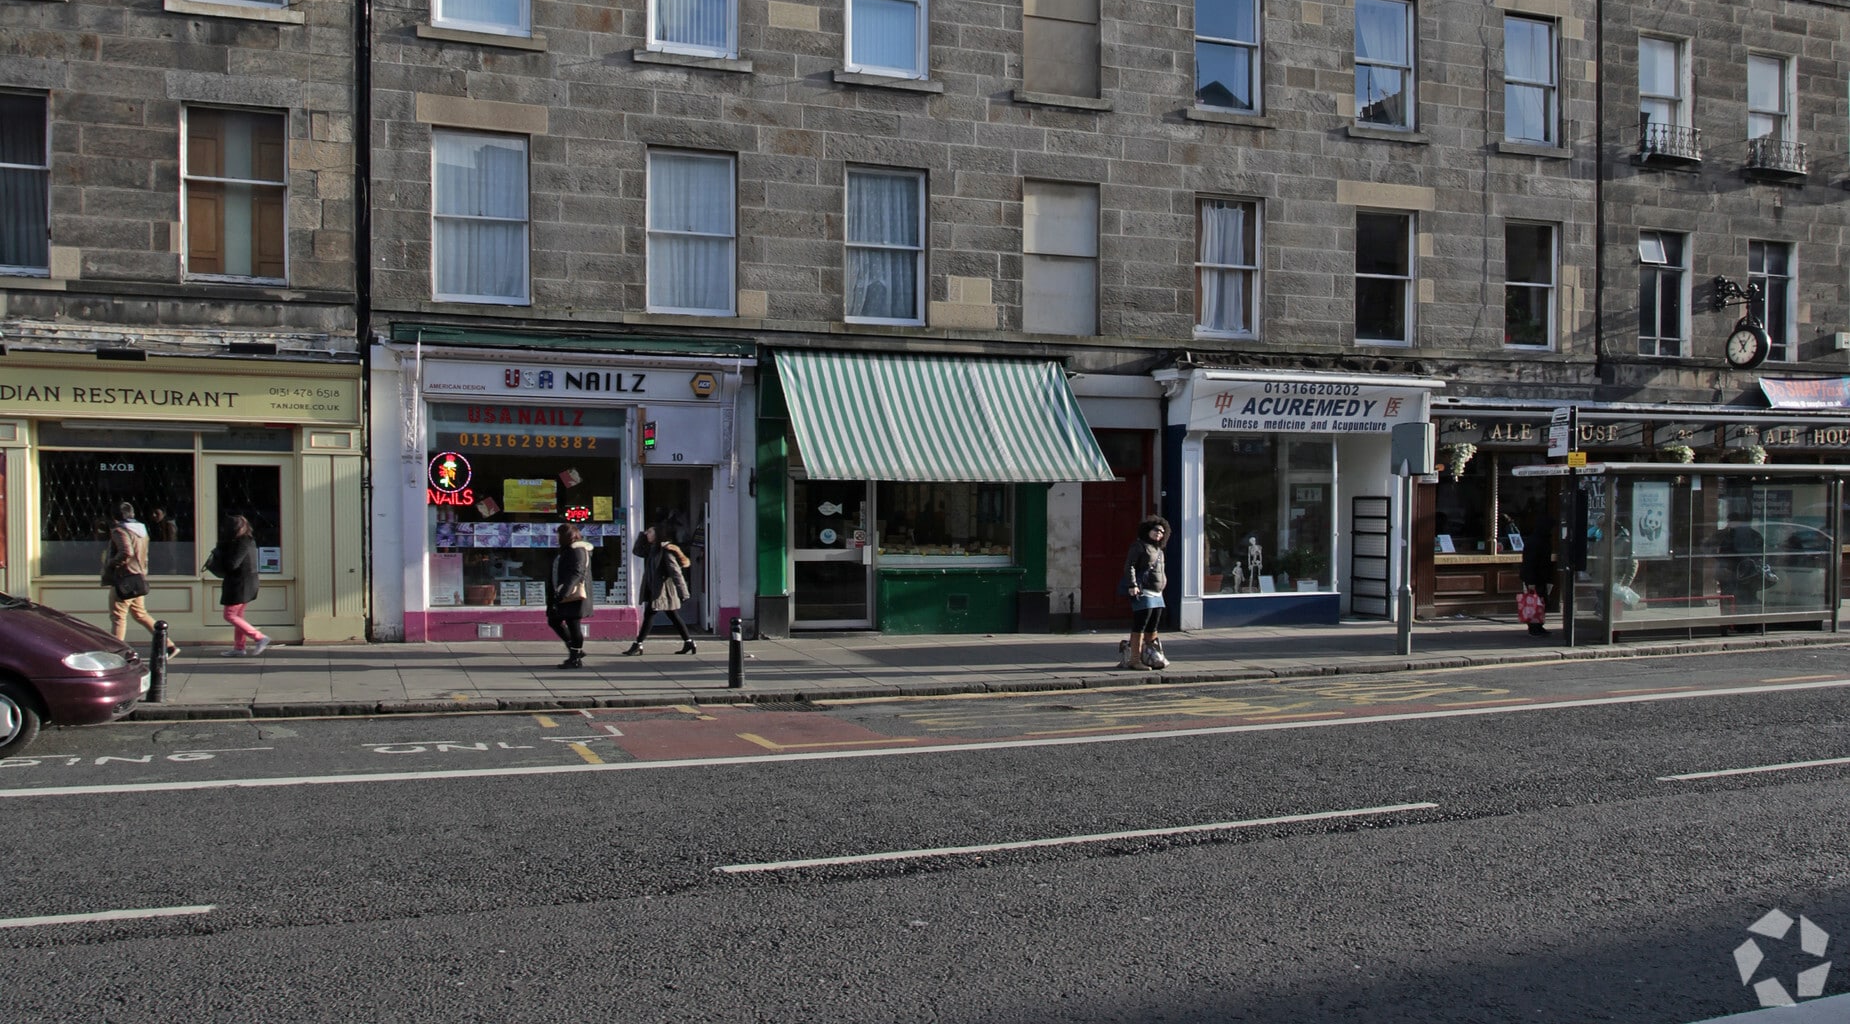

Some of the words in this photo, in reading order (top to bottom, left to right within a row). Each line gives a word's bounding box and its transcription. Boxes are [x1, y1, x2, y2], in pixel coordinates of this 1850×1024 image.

[505, 368, 554, 390] USA
[566, 372, 646, 392] NAILZ
[0, 384, 60, 402] DIAN
[72, 387, 239, 408] RESTAURANT
[269, 388, 290, 397] 0131
[293, 388, 313, 398] 478
[316, 388, 340, 398] 6518
[1264, 382, 1360, 396] 01316620202
[270, 402, 340, 411] TANJORE.CO.UK
[1214, 392, 1234, 414] 中
[1241, 398, 1377, 417] ACUREMEDY
[1384, 397, 1404, 418] 医
[468, 406, 512, 424] USA
[518, 407, 584, 426] NAILZ
[1222, 418, 1258, 430] Chinese
[1264, 419, 1306, 430] medicine
[1310, 420, 1328, 430] and
[1332, 420, 1387, 434] Acupuncture
[1460, 419, 1477, 430] the
[1491, 423, 1533, 440] ALE
[460, 432, 597, 450] 01316298382
[1766, 428, 1799, 444] ALE
[672, 453, 683, 462] 10
[426, 488, 474, 505] NAILS
[568, 509, 588, 519] OPEN
